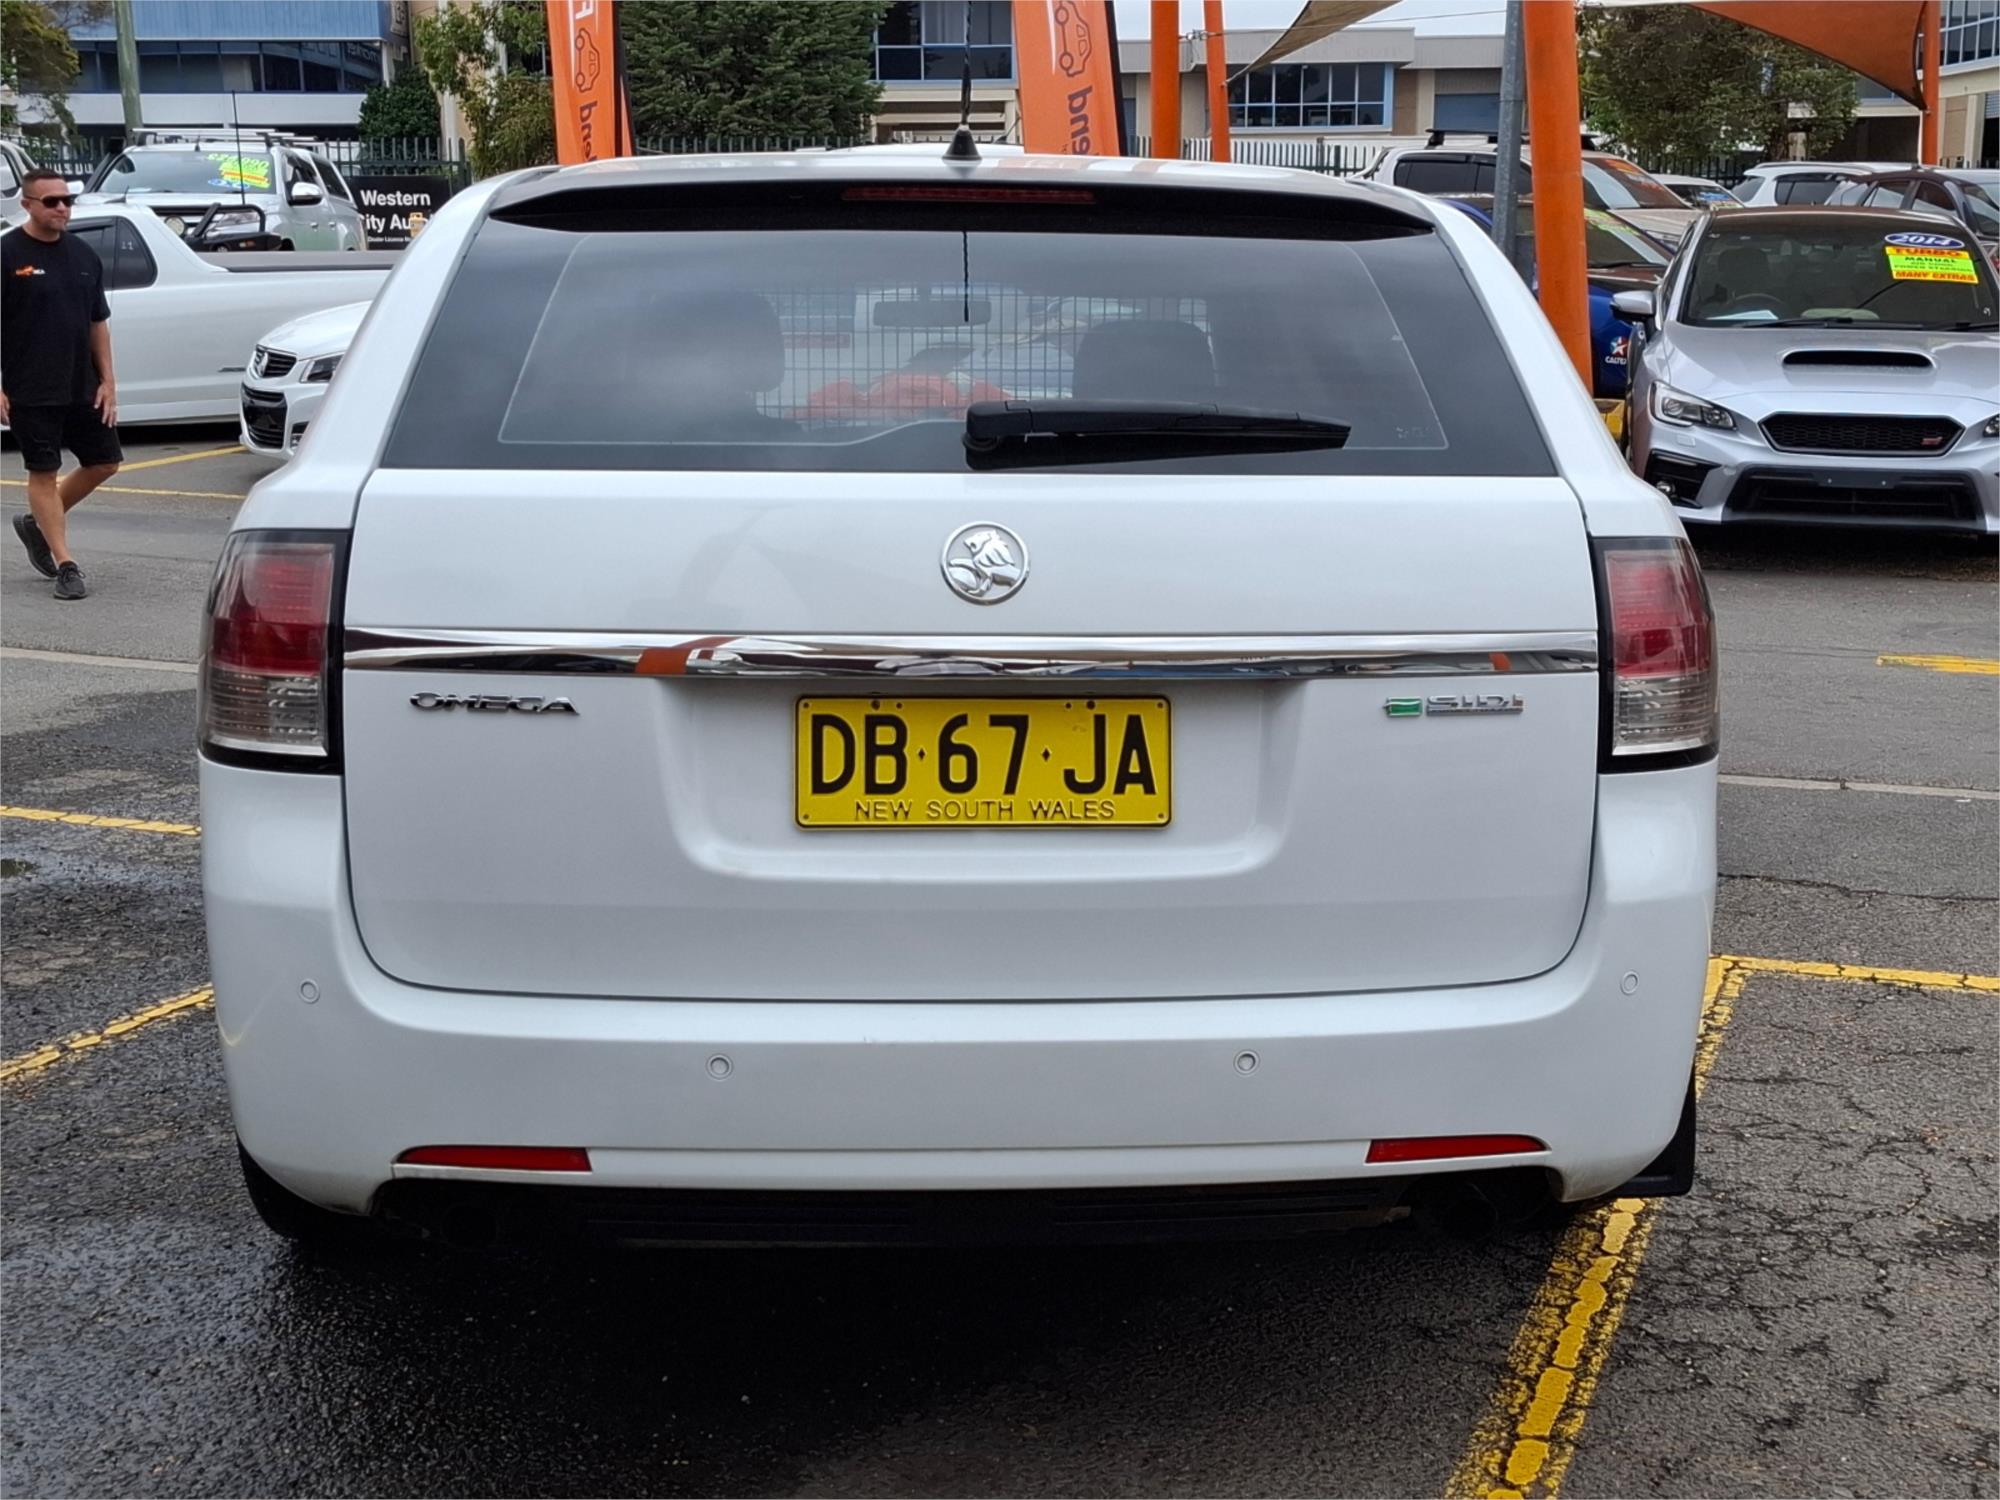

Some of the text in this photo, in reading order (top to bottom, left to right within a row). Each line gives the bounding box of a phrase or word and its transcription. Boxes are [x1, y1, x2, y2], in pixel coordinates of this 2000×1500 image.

[360, 189, 431, 206] Western
[1896, 234, 1952, 246] 2014
[1894, 248, 1962, 257] TURBO
[409, 692, 580, 716] OMEGA
[854, 799, 1116, 820] NEW SOUTH WALES
